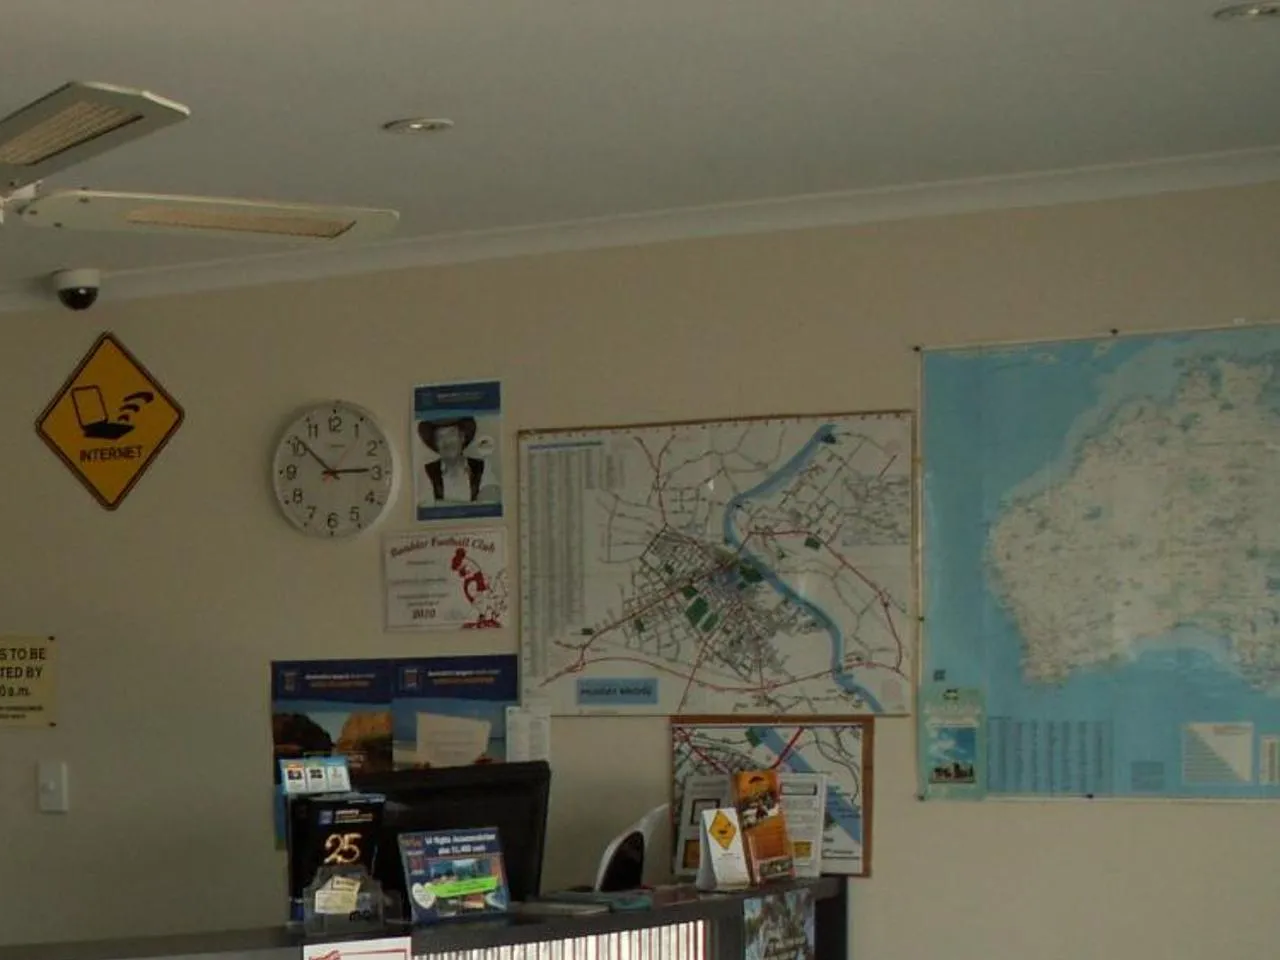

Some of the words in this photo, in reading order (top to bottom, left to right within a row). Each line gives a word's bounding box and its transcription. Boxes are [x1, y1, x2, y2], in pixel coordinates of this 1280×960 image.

[307, 423, 318, 438] 11
[328, 415, 342, 432] 12
[80, 446, 141, 461] INTERNET
[366, 440, 378, 456] 2
[286, 464, 297, 480] 9
[371, 466, 381, 480] 3
[292, 488, 302, 504] 8
[365, 490, 375, 504] 4
[307, 505, 317, 519] 7
[349, 506, 360, 521] 5
[327, 512, 338, 528] 6
[9, 648, 27, 660] TO
[30, 648, 46, 660] BE
[26, 667, 43, 678] BY
[323, 832, 362, 864] 25
